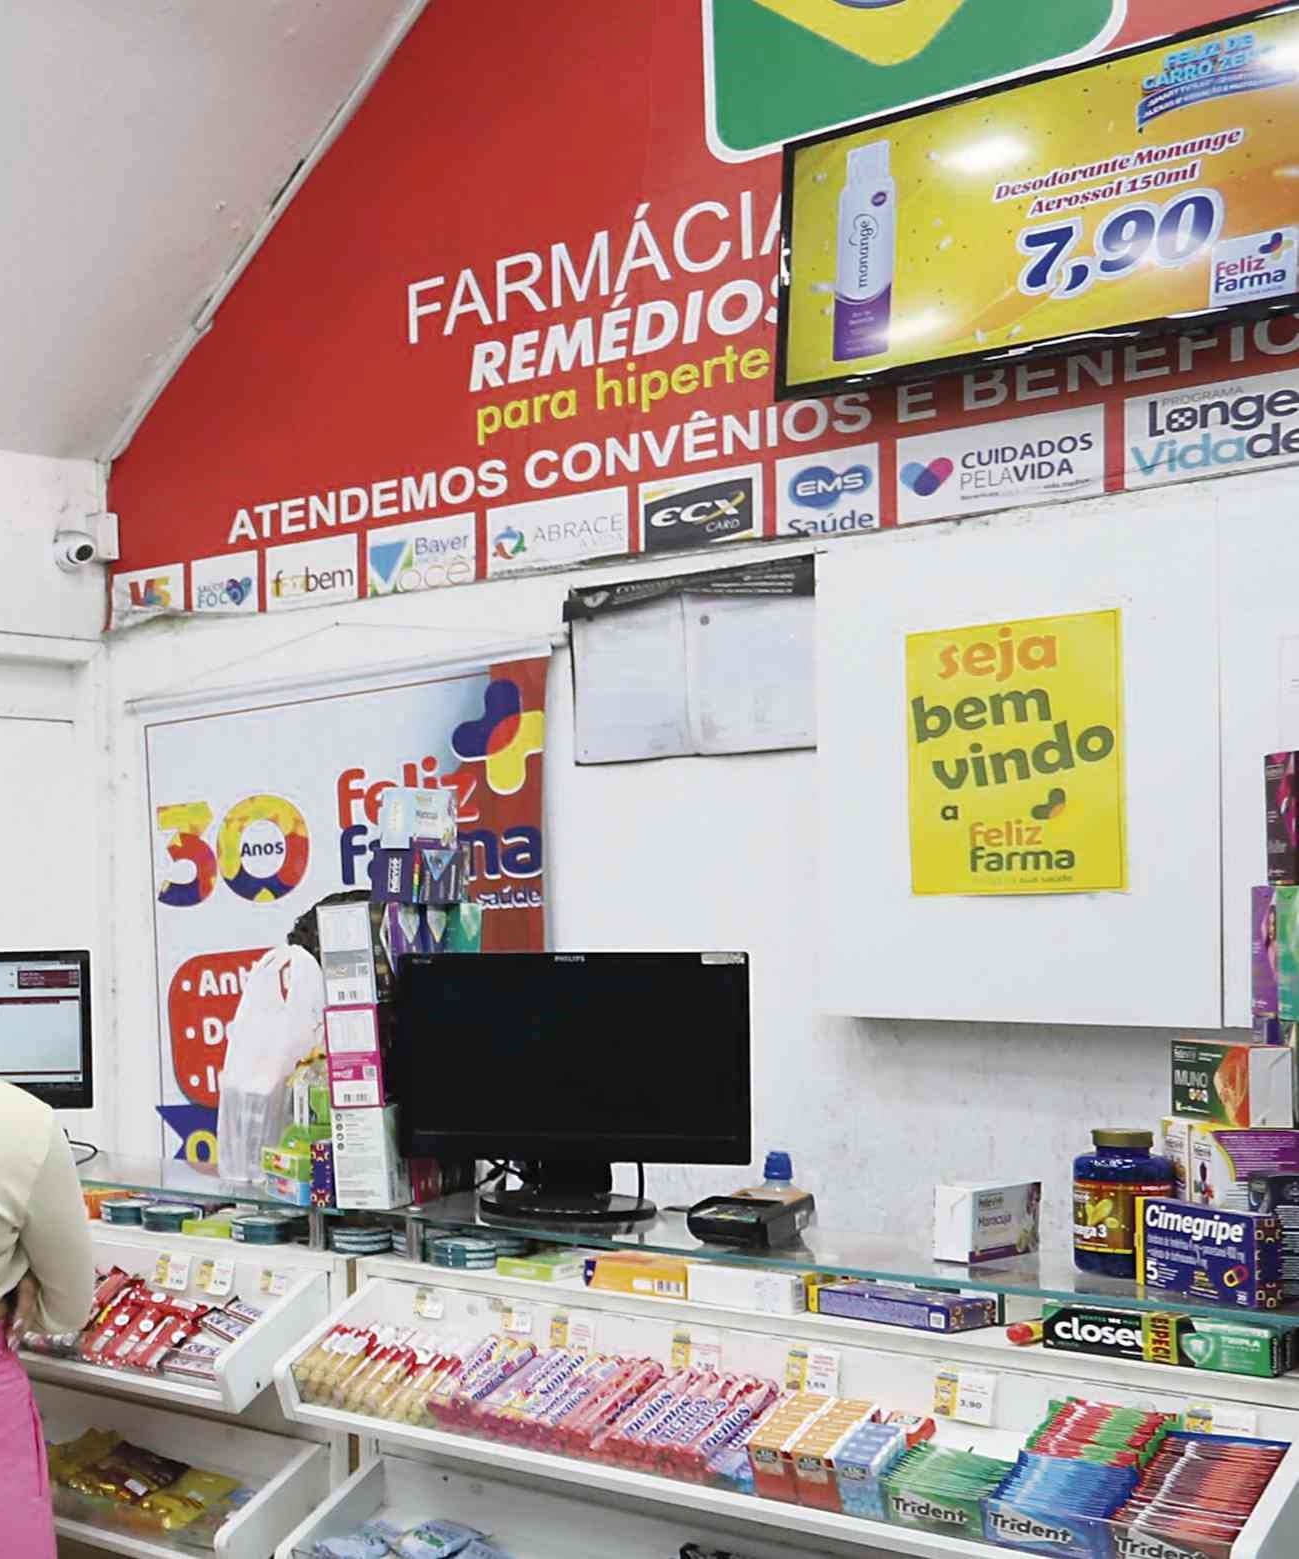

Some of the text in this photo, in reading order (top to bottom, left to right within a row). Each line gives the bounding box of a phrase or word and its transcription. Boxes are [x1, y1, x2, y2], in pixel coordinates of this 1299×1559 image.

[995, 128, 1242, 199] Desodorante Monange
[1029, 163, 1198, 215] Aerossol 150ml
[858, 219, 875, 289] monange
[1024, 195, 1215, 292] 7,90
[476, 345, 771, 446] para hiperte
[1162, 385, 1245, 407] PROGRAMA
[226, 459, 508, 545] ATENDEMOS
[524, 392, 873, 489] CONVÊNIOS
[896, 378, 937, 424] E
[961, 432, 1094, 470] CUIDADOS
[795, 472, 865, 498] EMS
[532, 512, 623, 543] ABRACE
[705, 517, 741, 533] CARD
[787, 509, 875, 536] Saúde
[414, 534, 469, 556] Bayer
[937, 626, 1059, 682] seja
[910, 687, 1053, 744] bem
[931, 719, 1115, 791] vindo
[939, 803, 960, 821] a
[156, 792, 310, 908] 30
[240, 839, 285, 858] Anos
[969, 818, 1043, 848] feliz
[969, 845, 1076, 873] farma
[1145, 1203, 1245, 1245] Cimegripe
[891, 1496, 969, 1524] Trident
[988, 1511, 1073, 1544] Trident
